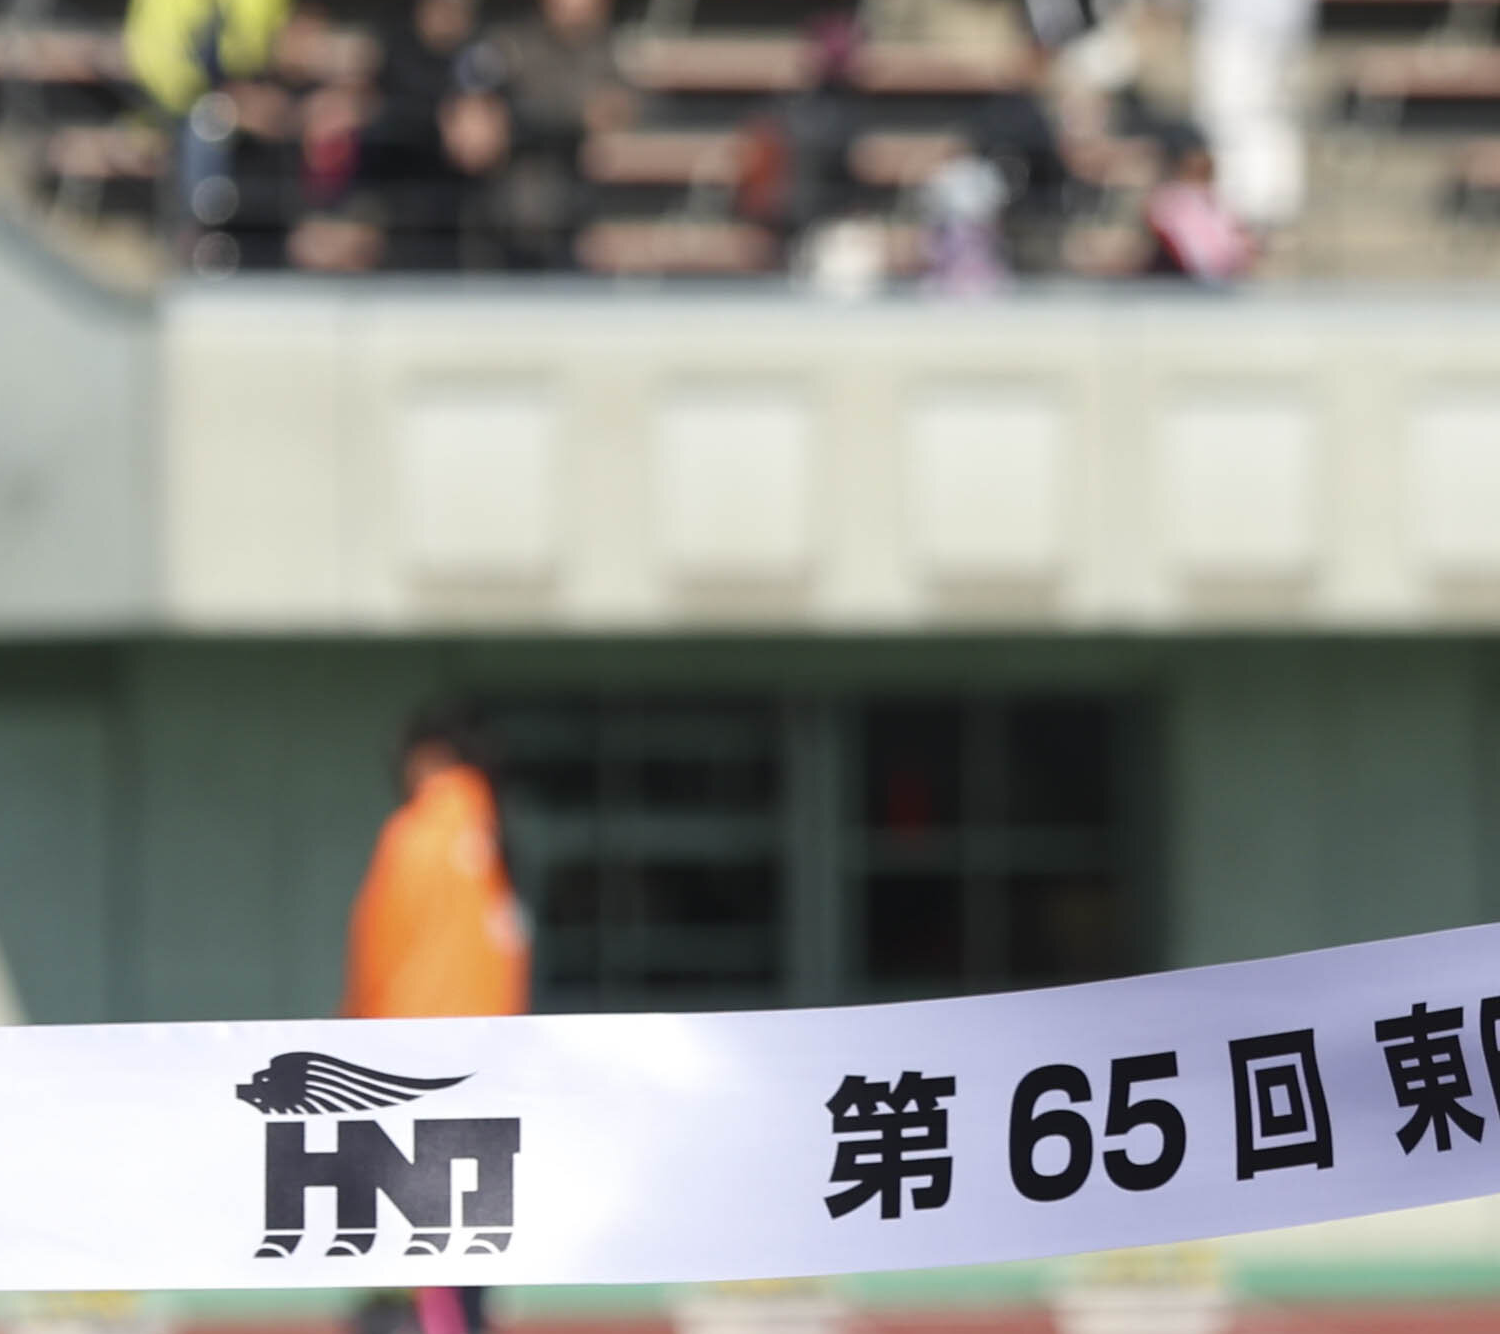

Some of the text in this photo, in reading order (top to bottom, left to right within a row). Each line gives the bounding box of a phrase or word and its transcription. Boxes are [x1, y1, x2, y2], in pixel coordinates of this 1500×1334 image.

[823, 1071, 956, 1220] 第
[1008, 1051, 1187, 1202] 65
[1228, 1028, 1334, 1181] 回
